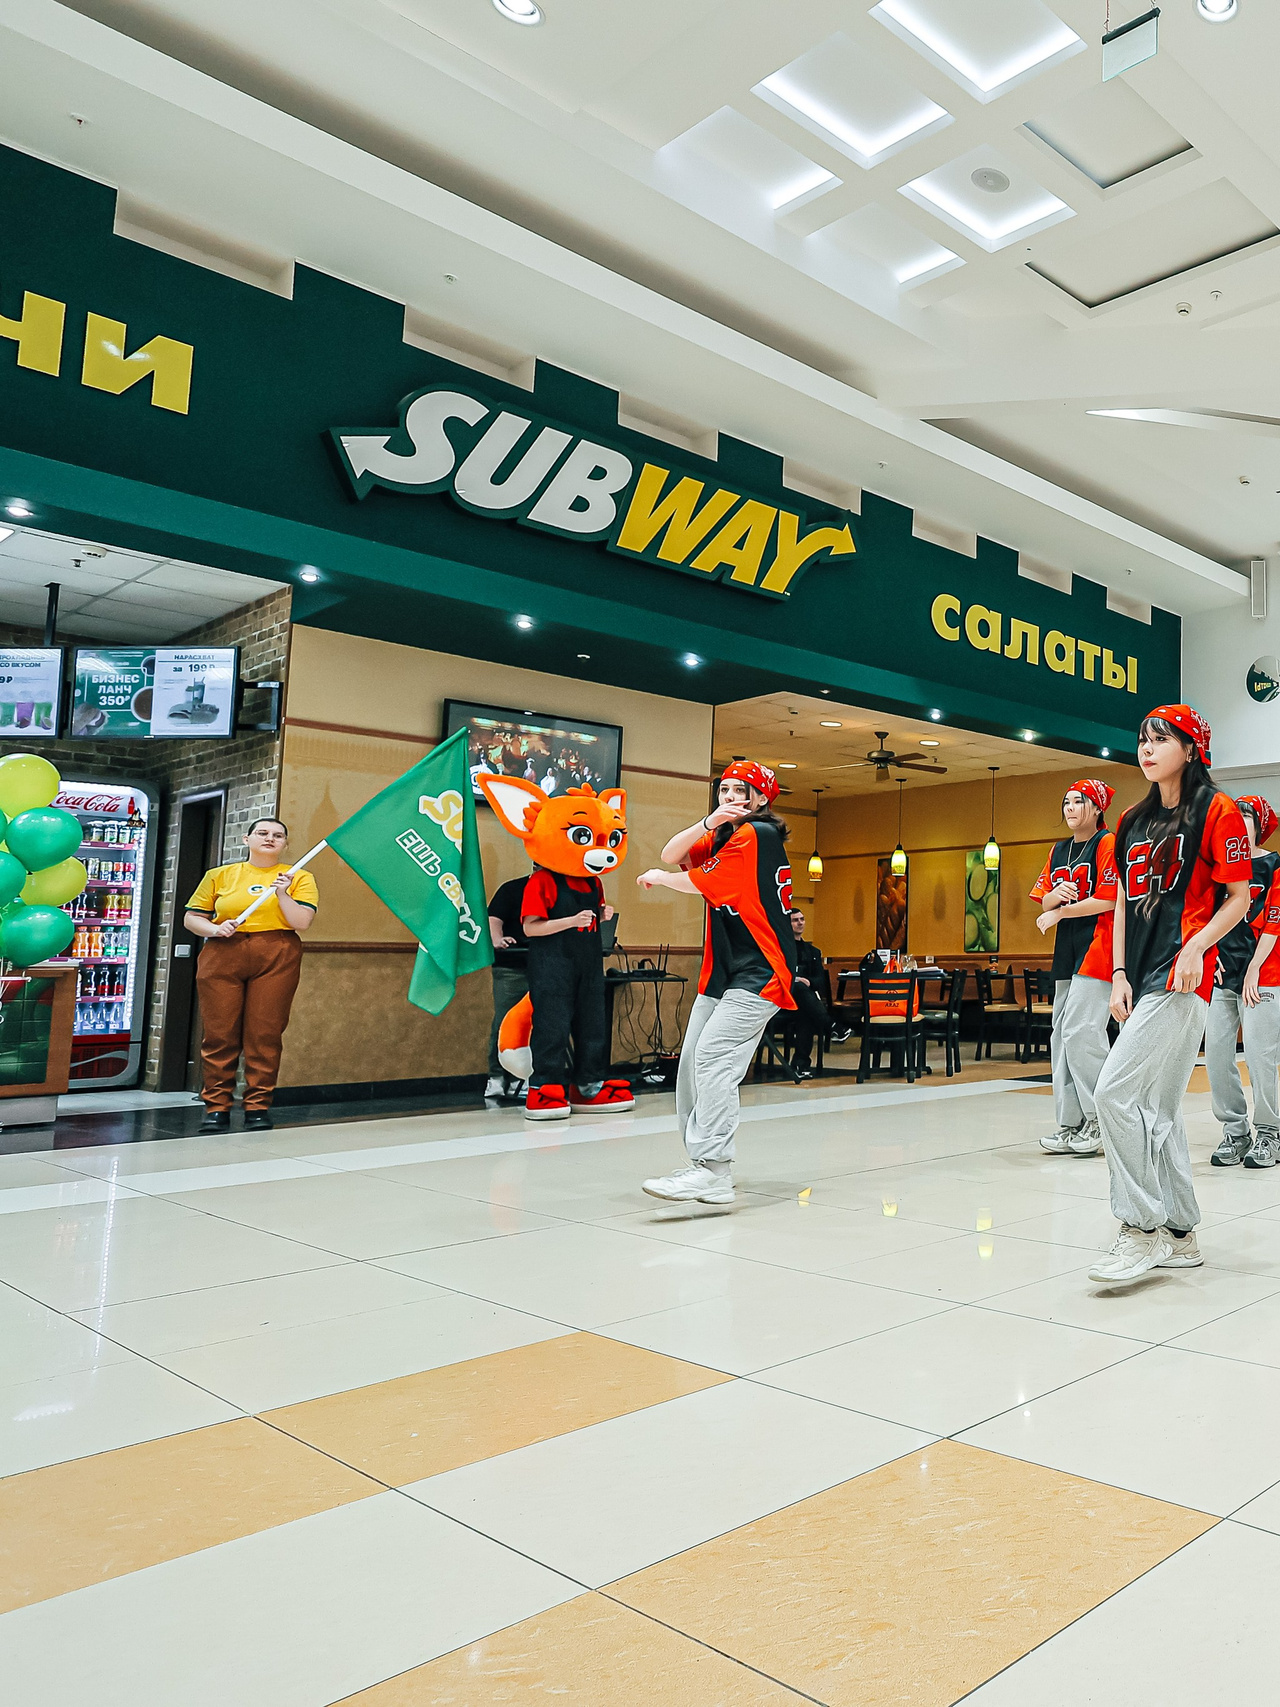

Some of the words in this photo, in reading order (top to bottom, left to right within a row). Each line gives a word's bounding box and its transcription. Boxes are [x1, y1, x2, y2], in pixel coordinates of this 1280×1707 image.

[340, 390, 858, 595] SUBWAY
[930, 592, 1140, 694] салаты
[92, 674, 140, 684] БИЗНЕС
[98, 685, 132, 694] ЛАНЧ
[1126, 833, 1185, 900] 24
[1225, 836, 1251, 863] 24
